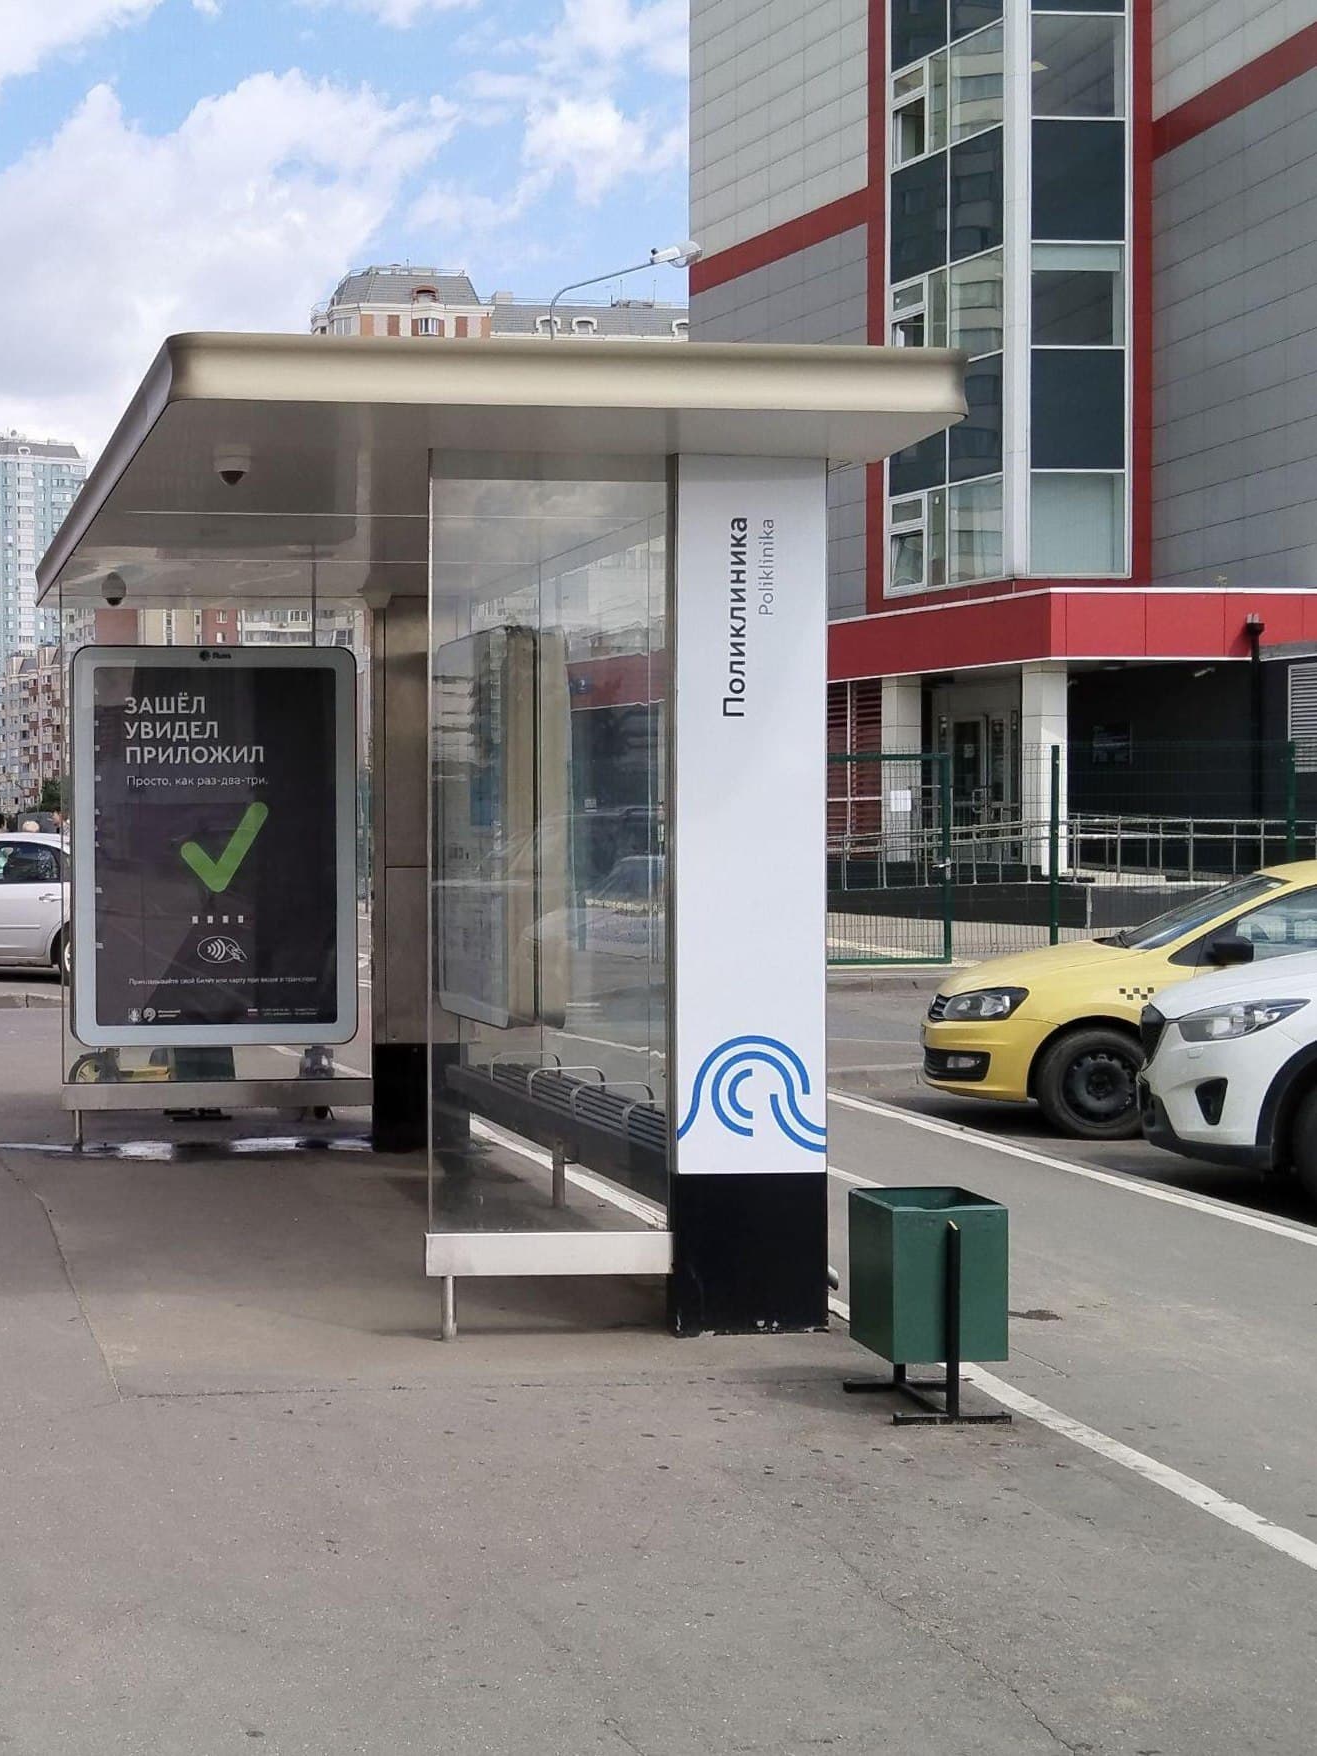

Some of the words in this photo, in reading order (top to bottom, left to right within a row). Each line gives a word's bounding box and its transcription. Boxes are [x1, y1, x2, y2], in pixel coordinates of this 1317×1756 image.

[758, 518, 774, 616] Poliklinika
[722, 516, 748, 717] Поликлиника
[124, 692, 206, 714] ЗАШЁЛ
[124, 721, 219, 743] УВИДЕЛ
[125, 745, 264, 764] ПРИЛОЖИЛ
[126, 775, 172, 788] Просто,
[175, 776, 196, 786] как
[197, 775, 269, 788] раз-два-три.
